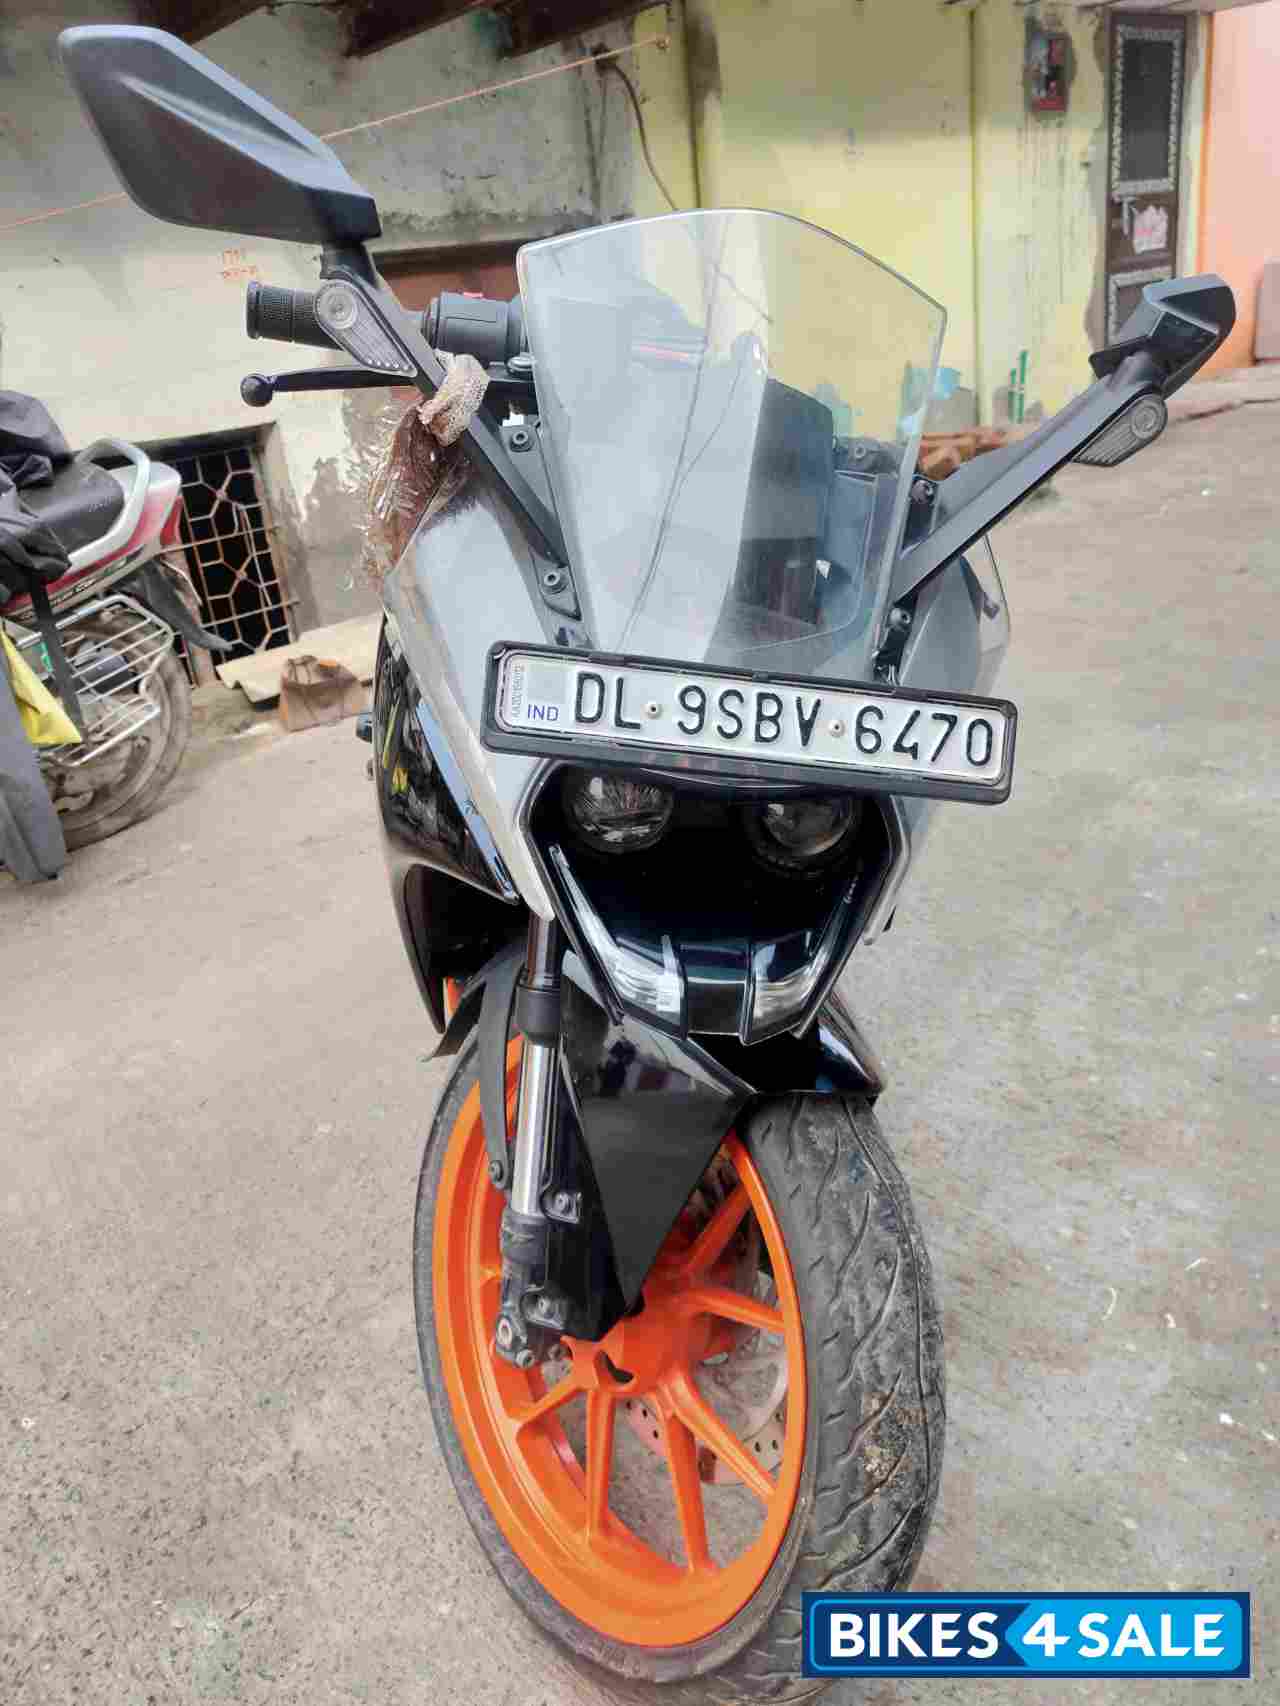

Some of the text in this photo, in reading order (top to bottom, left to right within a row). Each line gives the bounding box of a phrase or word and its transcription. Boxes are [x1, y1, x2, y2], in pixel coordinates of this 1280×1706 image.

[527, 703, 560, 722] IND
[575, 671, 641, 730] DL
[677, 685, 822, 747] 9SBV
[855, 705, 993, 767] 6470
